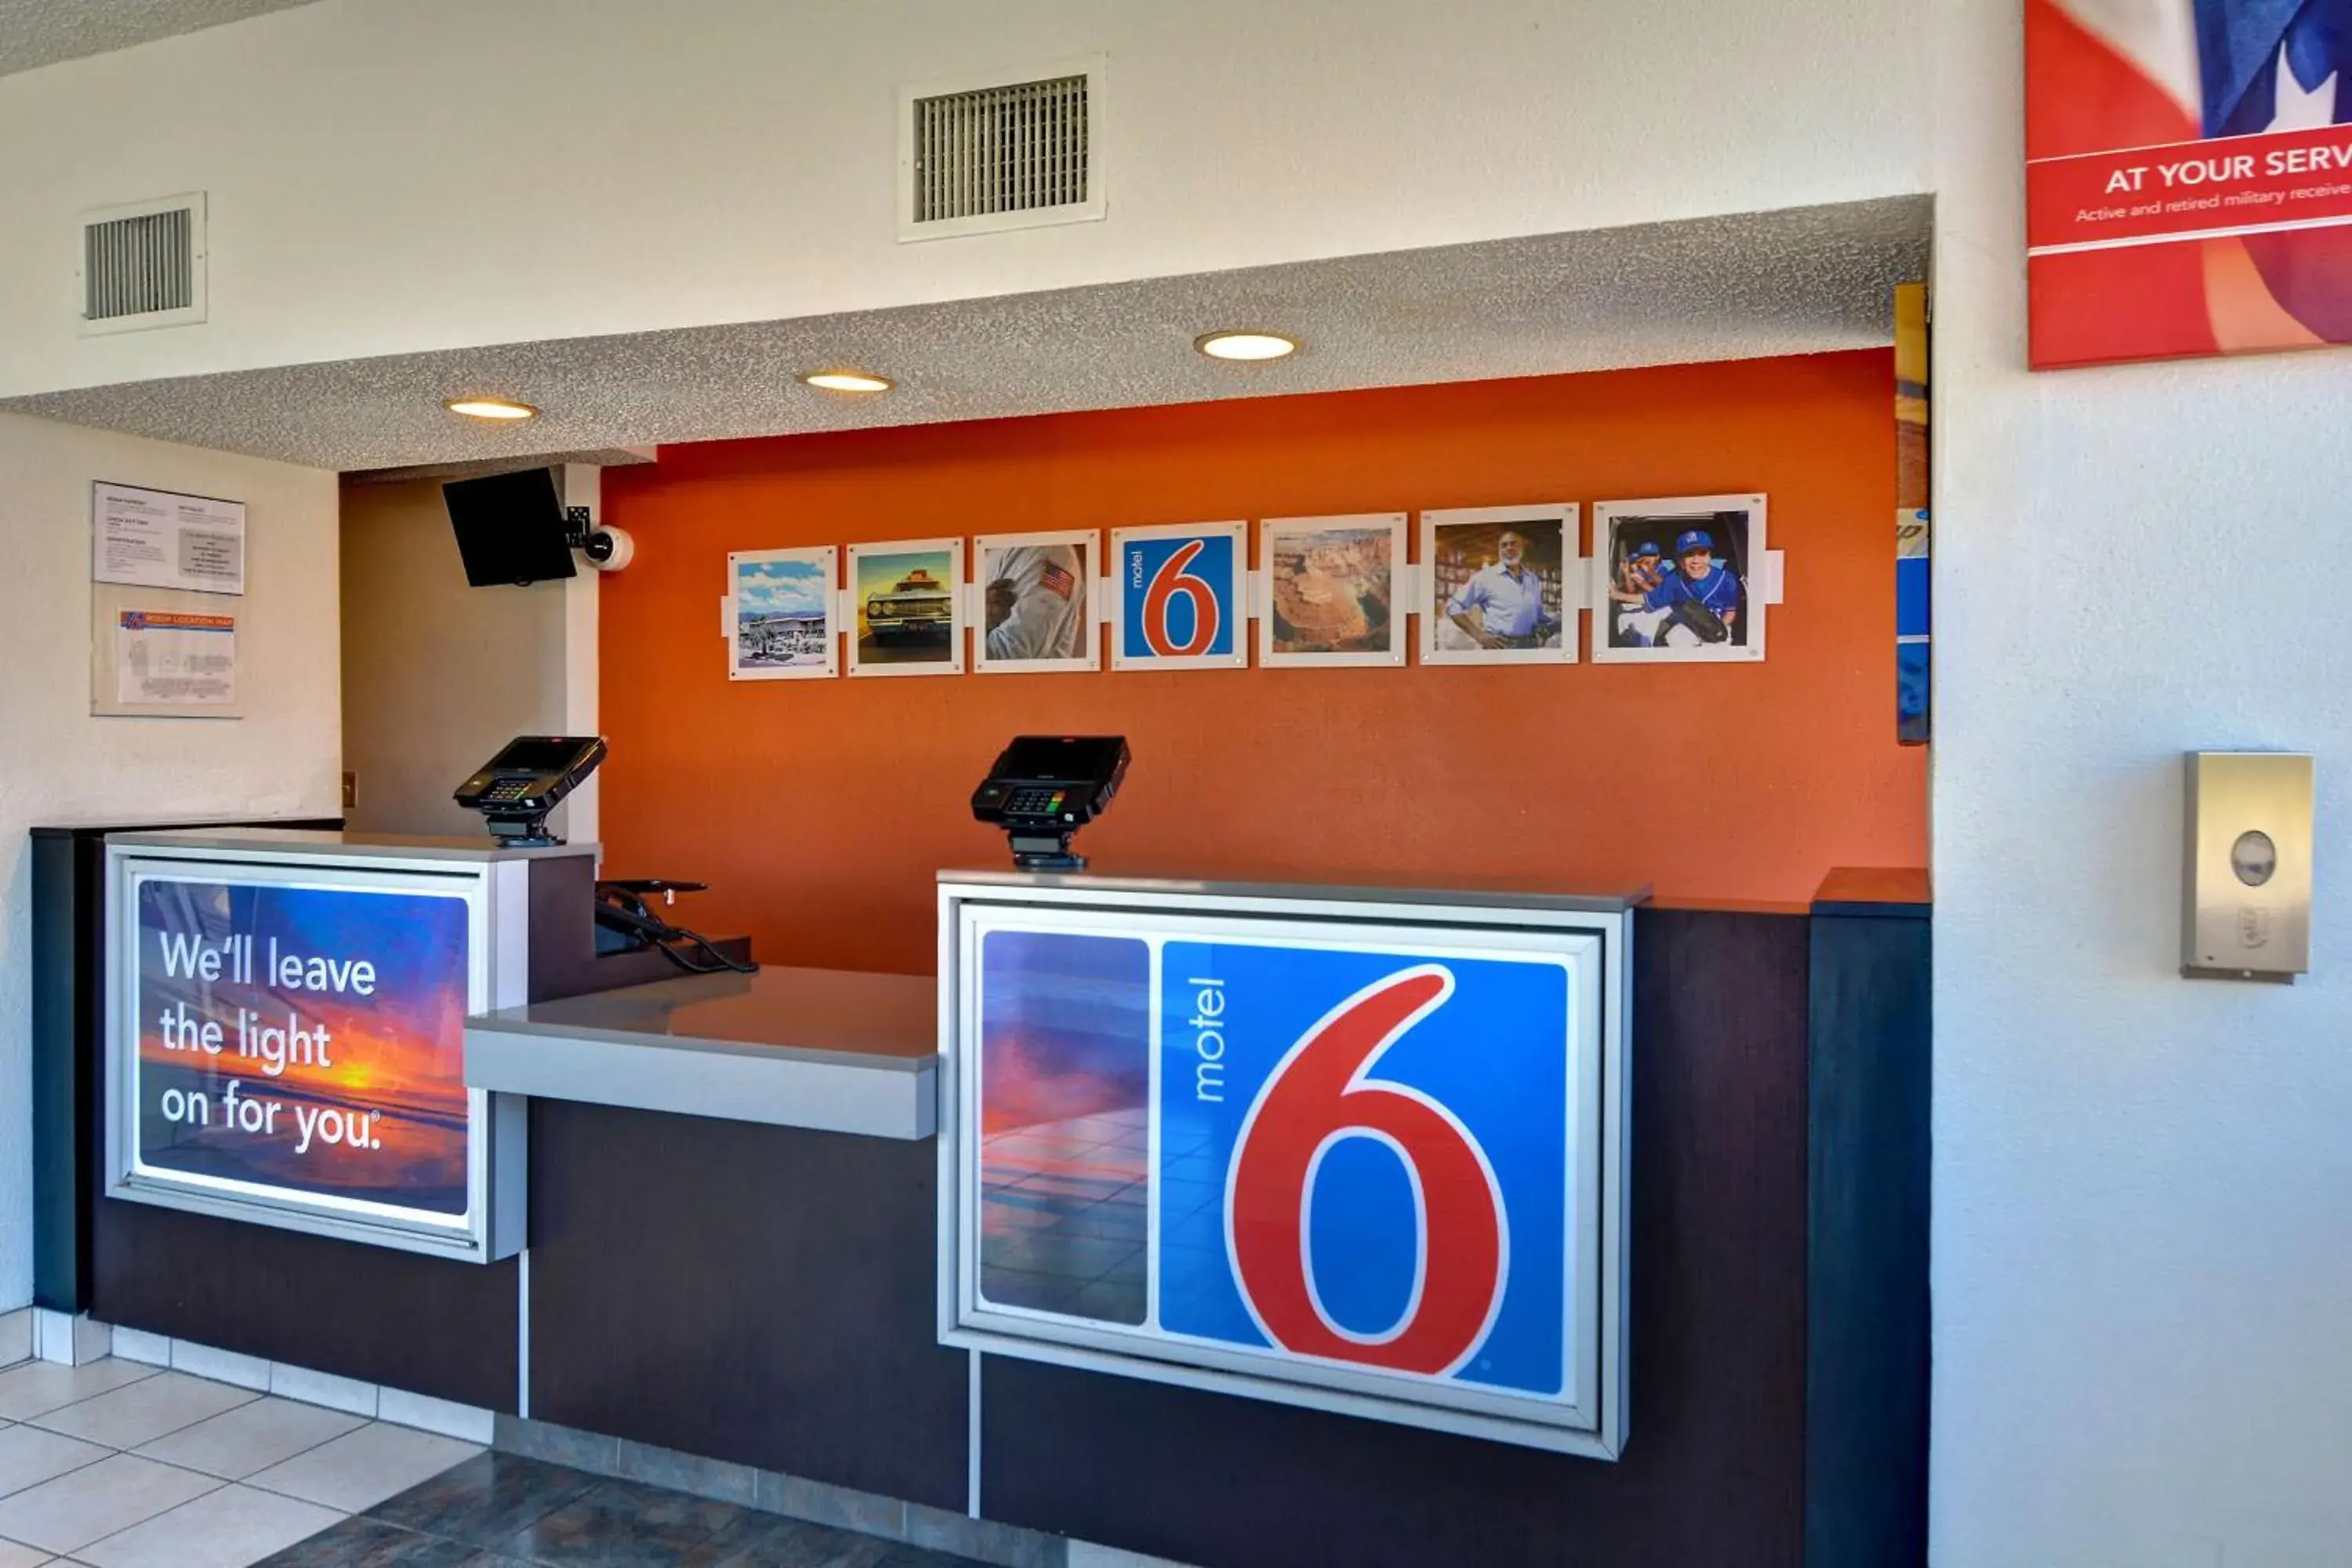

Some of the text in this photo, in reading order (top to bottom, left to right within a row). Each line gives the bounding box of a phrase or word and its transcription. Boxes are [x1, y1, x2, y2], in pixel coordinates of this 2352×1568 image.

[2105, 143, 2352, 194] AT YOUR SERV
[2075, 183, 2351, 222] Active and retired military receive
[1131, 539, 1220, 657] motel 6
[160, 931, 376, 996] We'll leave
[159, 1001, 332, 1076] the light
[161, 1088, 208, 1125] on
[223, 1080, 281, 1134] for
[1189, 963, 1510, 1378] motel 6
